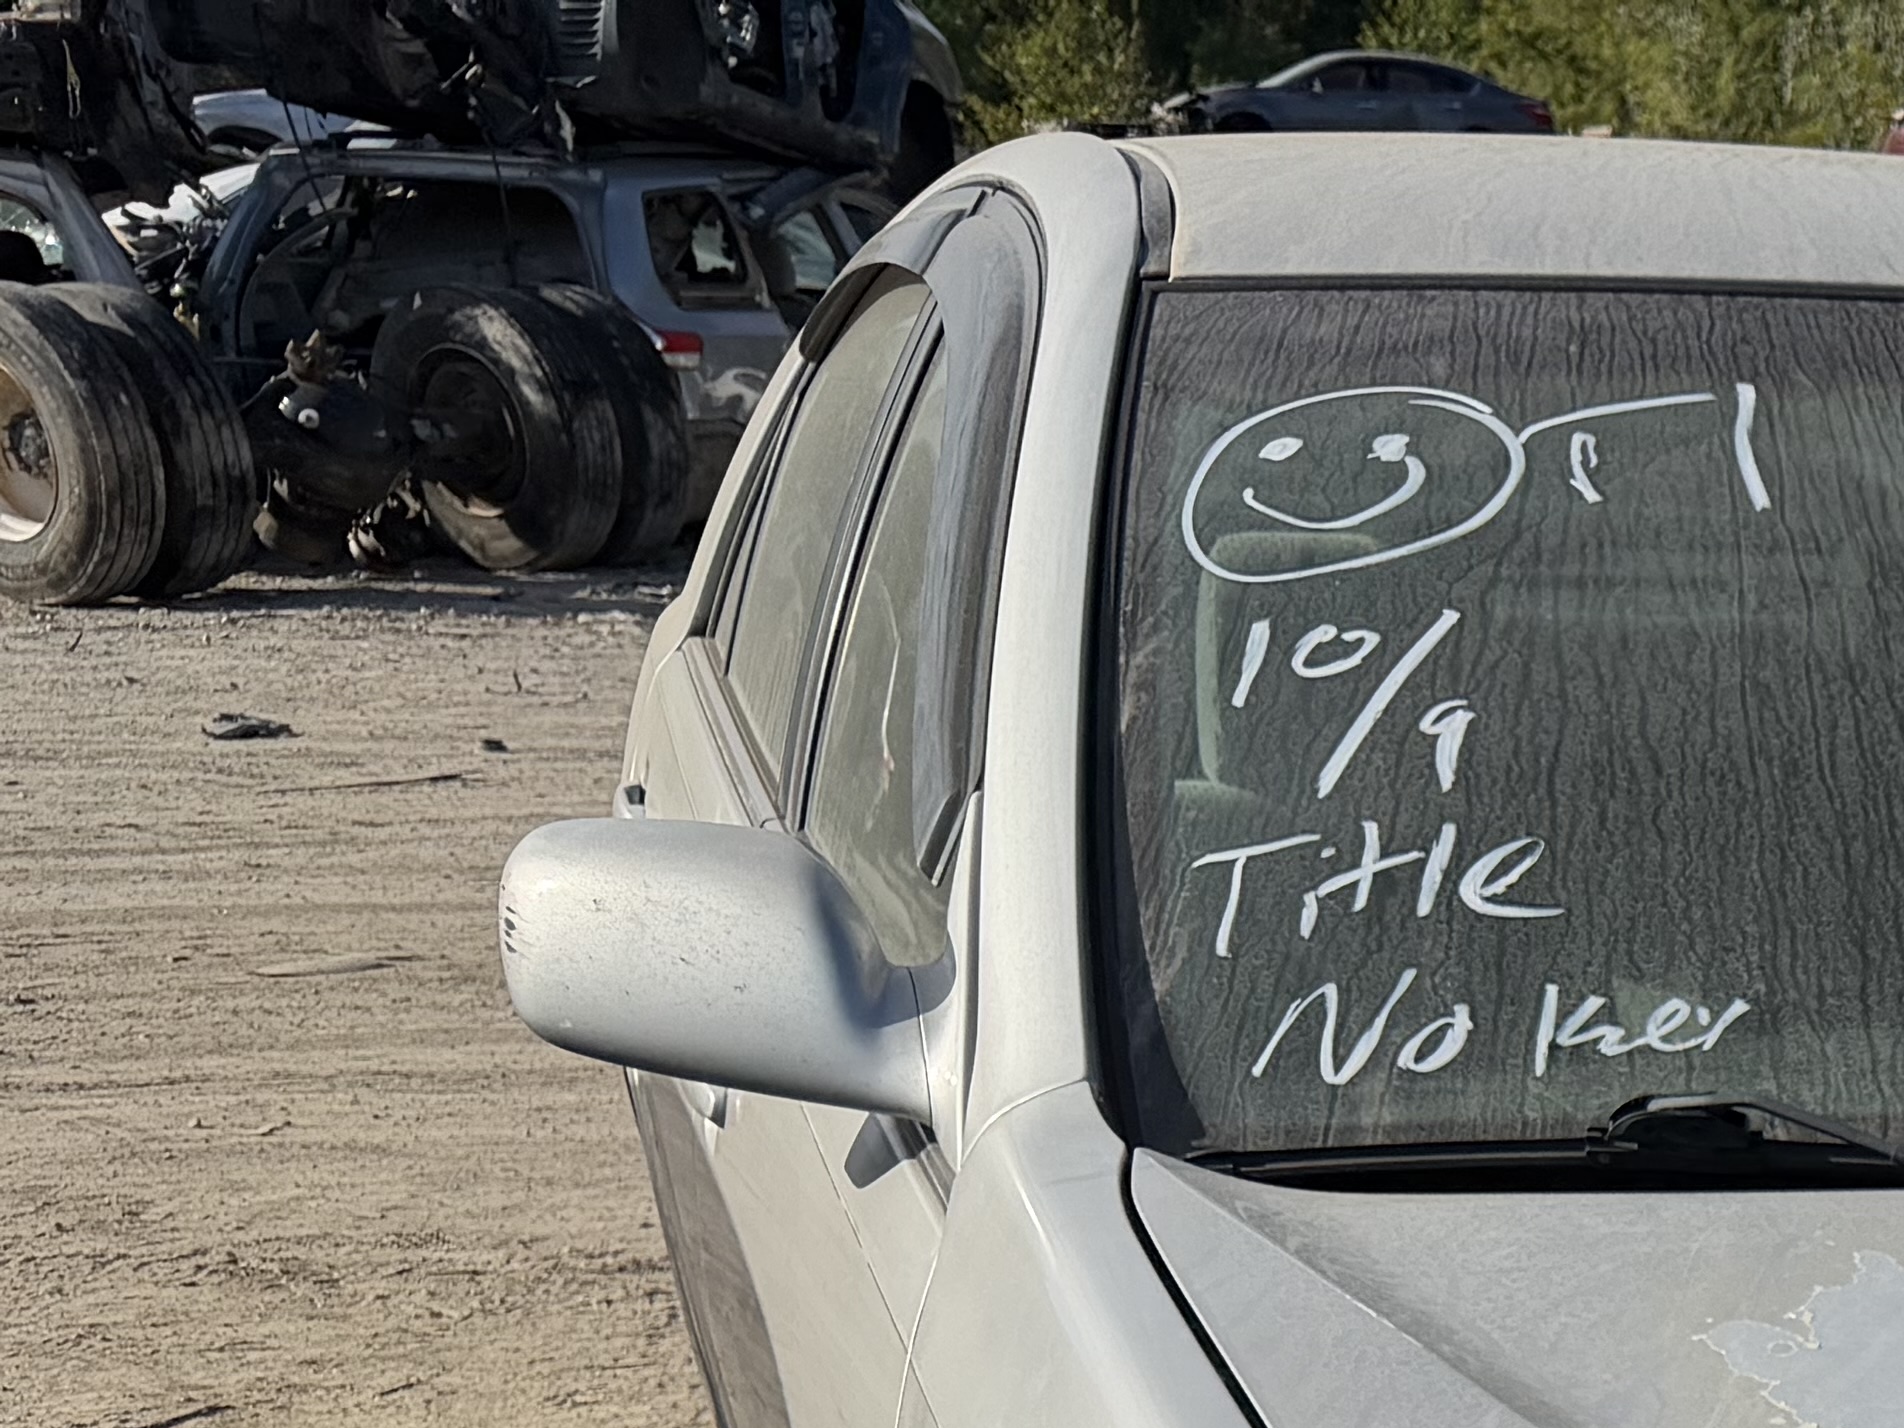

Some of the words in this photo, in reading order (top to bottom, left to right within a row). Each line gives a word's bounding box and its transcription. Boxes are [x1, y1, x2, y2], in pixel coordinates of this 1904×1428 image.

[1231, 609, 1476, 798] 10/9
[1192, 821, 1566, 958] Title
[1251, 967, 1473, 1086] No
